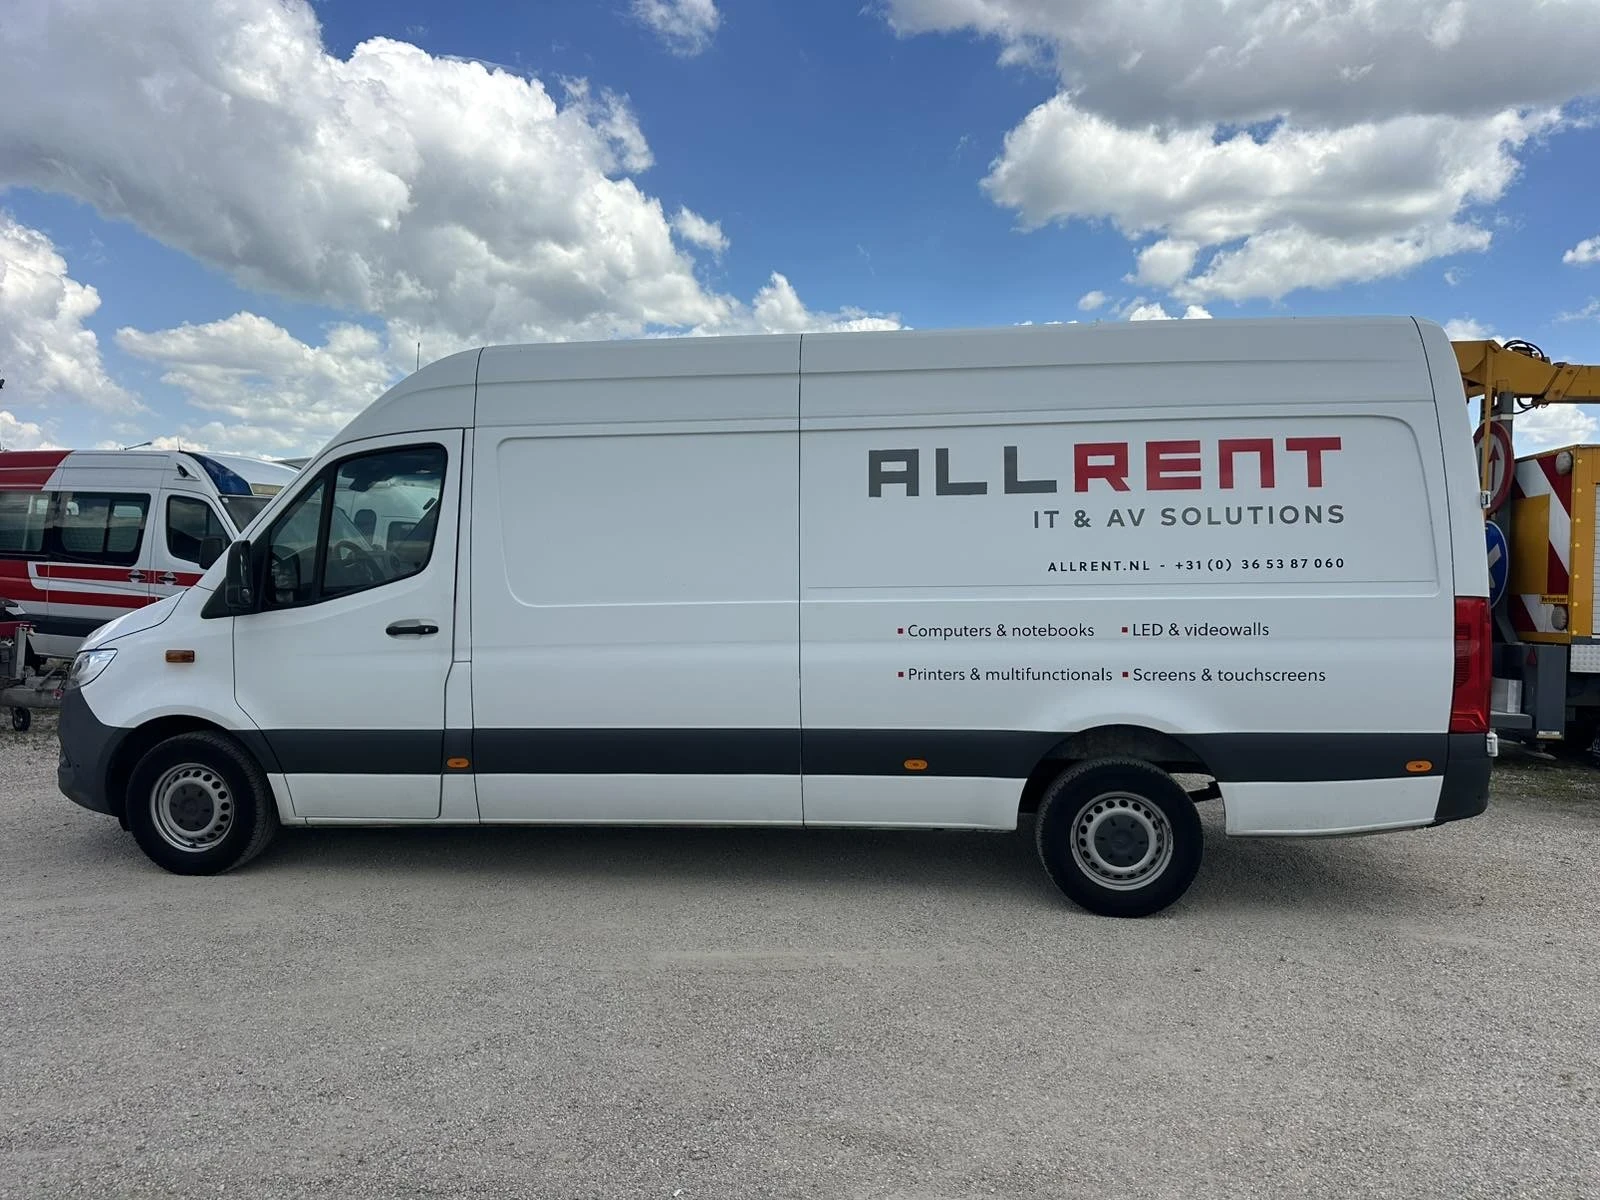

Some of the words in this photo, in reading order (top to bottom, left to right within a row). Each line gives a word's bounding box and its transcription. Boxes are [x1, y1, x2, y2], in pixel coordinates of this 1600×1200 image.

[869, 437, 1341, 497] ALLRENT
[1033, 510, 1060, 529] IT
[1073, 509, 1092, 529] &
[1107, 508, 1146, 528] AV
[1160, 504, 1345, 527] SOLUTIONS
[1047, 560, 1151, 573] ALLRENT.NL
[907, 624, 992, 641] Computers
[996, 623, 1008, 637] &
[1011, 622, 1095, 637] notebooks
[1132, 623, 1164, 637] LED
[1168, 622, 1181, 637] &
[1183, 621, 1270, 637] videowalls
[908, 666, 966, 681] Printers
[969, 666, 981, 681] &
[985, 666, 1113, 682] multifunctionals
[1132, 667, 1197, 682] Screens
[1200, 667, 1213, 682] &
[1217, 667, 1327, 682] touchscreens
